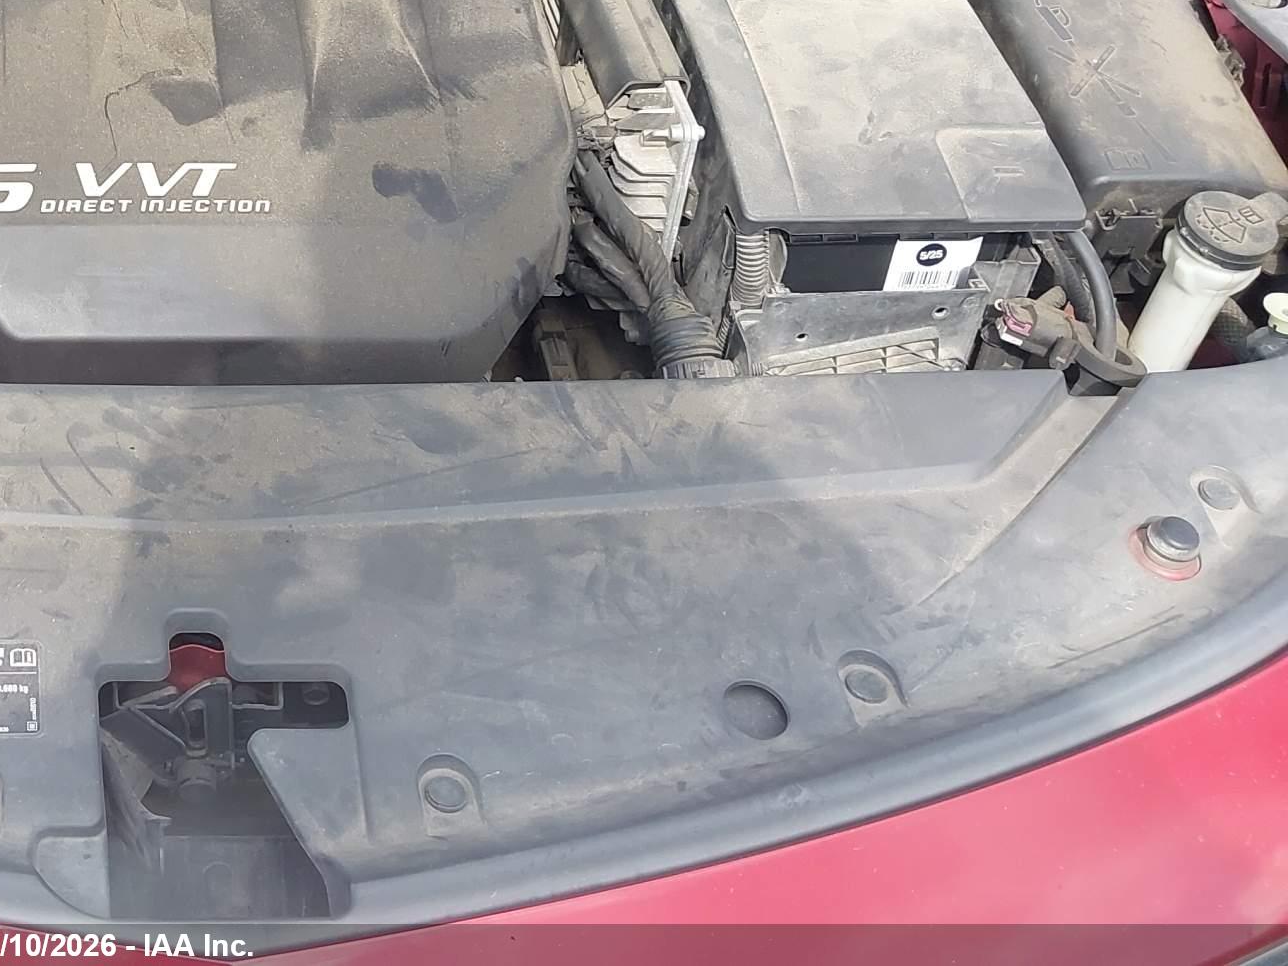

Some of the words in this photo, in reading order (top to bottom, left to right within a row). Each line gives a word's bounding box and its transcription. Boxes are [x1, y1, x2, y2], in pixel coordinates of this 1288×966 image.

[75, 162, 238, 197] VVT
[40, 199, 133, 213] DIRECT
[140, 199, 272, 213] INJECTION
[919, 250, 943, 260] 5/25
[19, 683, 30, 695] kg
